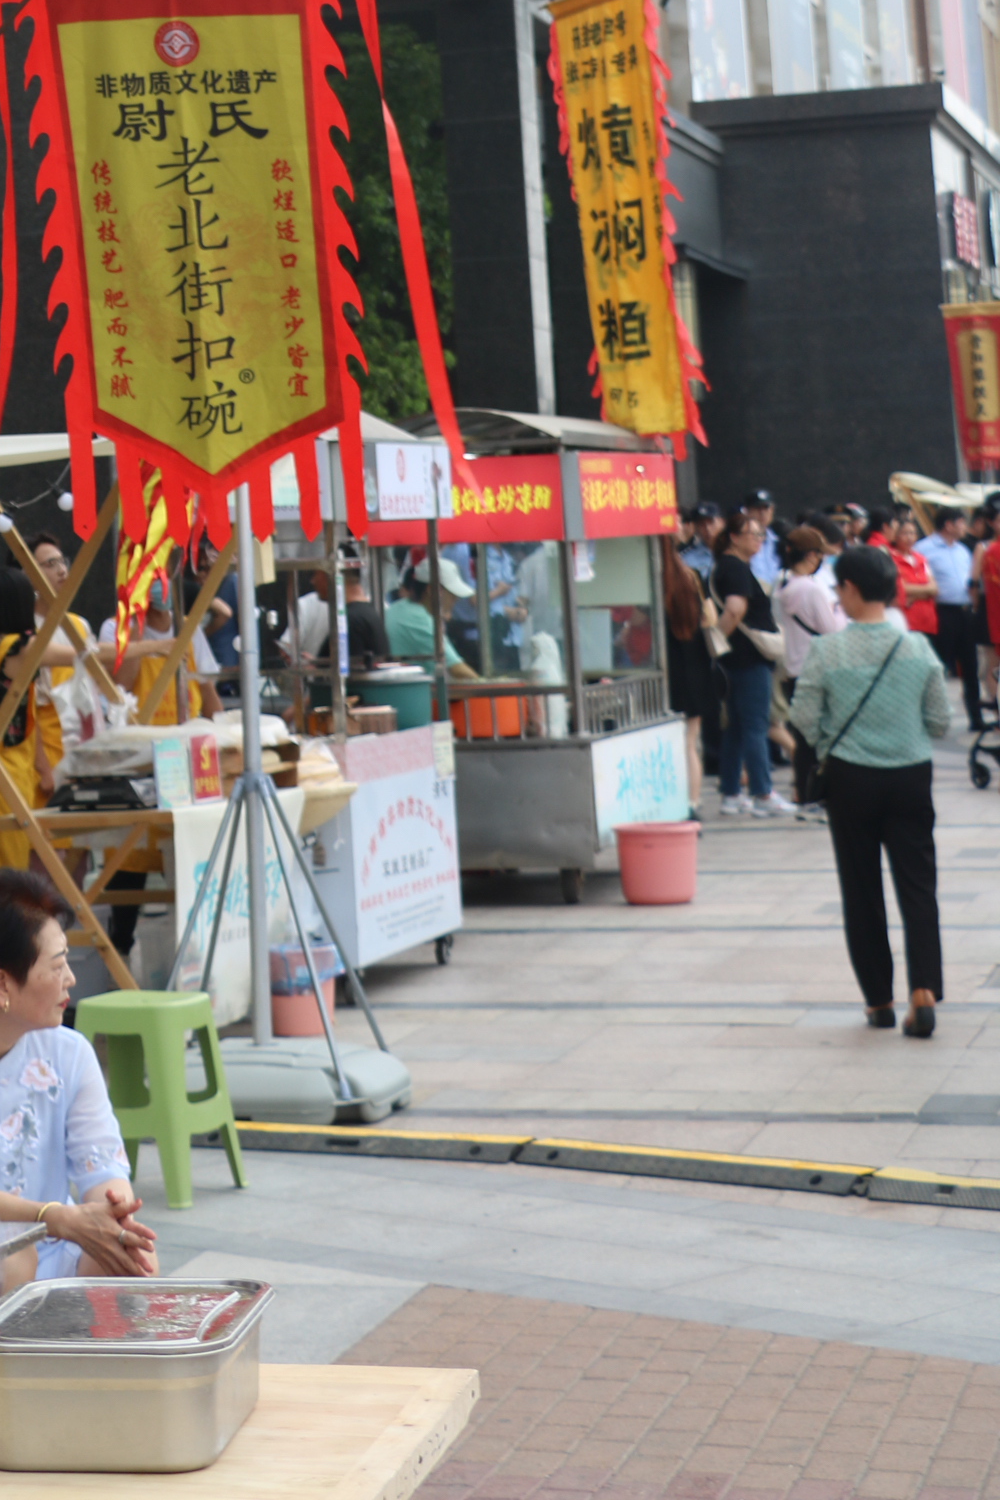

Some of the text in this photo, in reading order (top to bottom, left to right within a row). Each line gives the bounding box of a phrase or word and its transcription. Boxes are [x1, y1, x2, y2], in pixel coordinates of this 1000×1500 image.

[95, 69, 277, 98] 非物质文化遗产
[112, 99, 269, 142] 尉氏
[91, 160, 136, 400] 传统技艺 肥而不腻
[155, 137, 243, 440] 老北街扣碗
[280, 287, 310, 398] 老少皆宜
